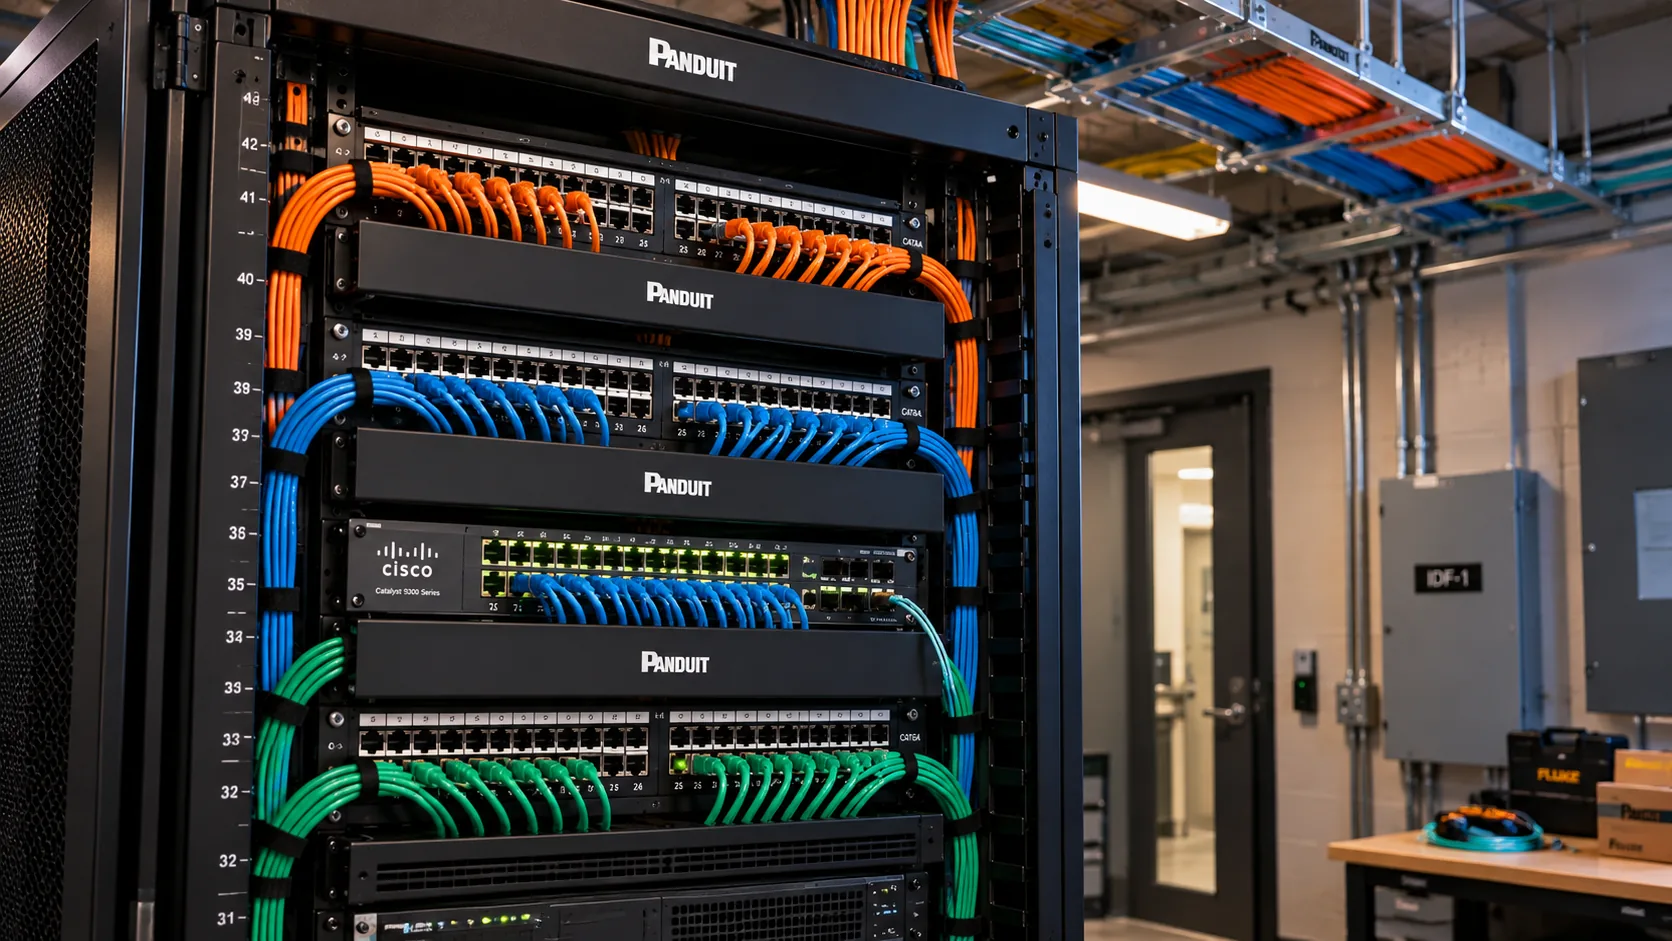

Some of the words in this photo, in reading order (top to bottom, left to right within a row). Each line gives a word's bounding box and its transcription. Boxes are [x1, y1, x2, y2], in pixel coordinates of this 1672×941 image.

[648, 37, 738, 82] PANDUIT
[241, 137, 258, 151] 42
[240, 191, 255, 204] 41
[237, 272, 254, 285] 40
[646, 280, 715, 309] PANDUIT
[235, 327, 252, 341] 39
[230, 475, 248, 489] 37
[644, 471, 713, 497] PANDUIT
[228, 526, 246, 540] 36
[382, 560, 433, 578] cisco
[227, 577, 245, 591] 35
[1426, 568, 1469, 588] IDF-1
[375, 587, 402, 597] Catalyst
[421, 588, 441, 597] Series
[641, 650, 710, 673] PANDUIT
[222, 732, 240, 747] 33
[1537, 767, 1581, 784] FLUKE
[220, 785, 239, 799] 32
[219, 853, 237, 868] 32
[217, 911, 234, 926] 31
